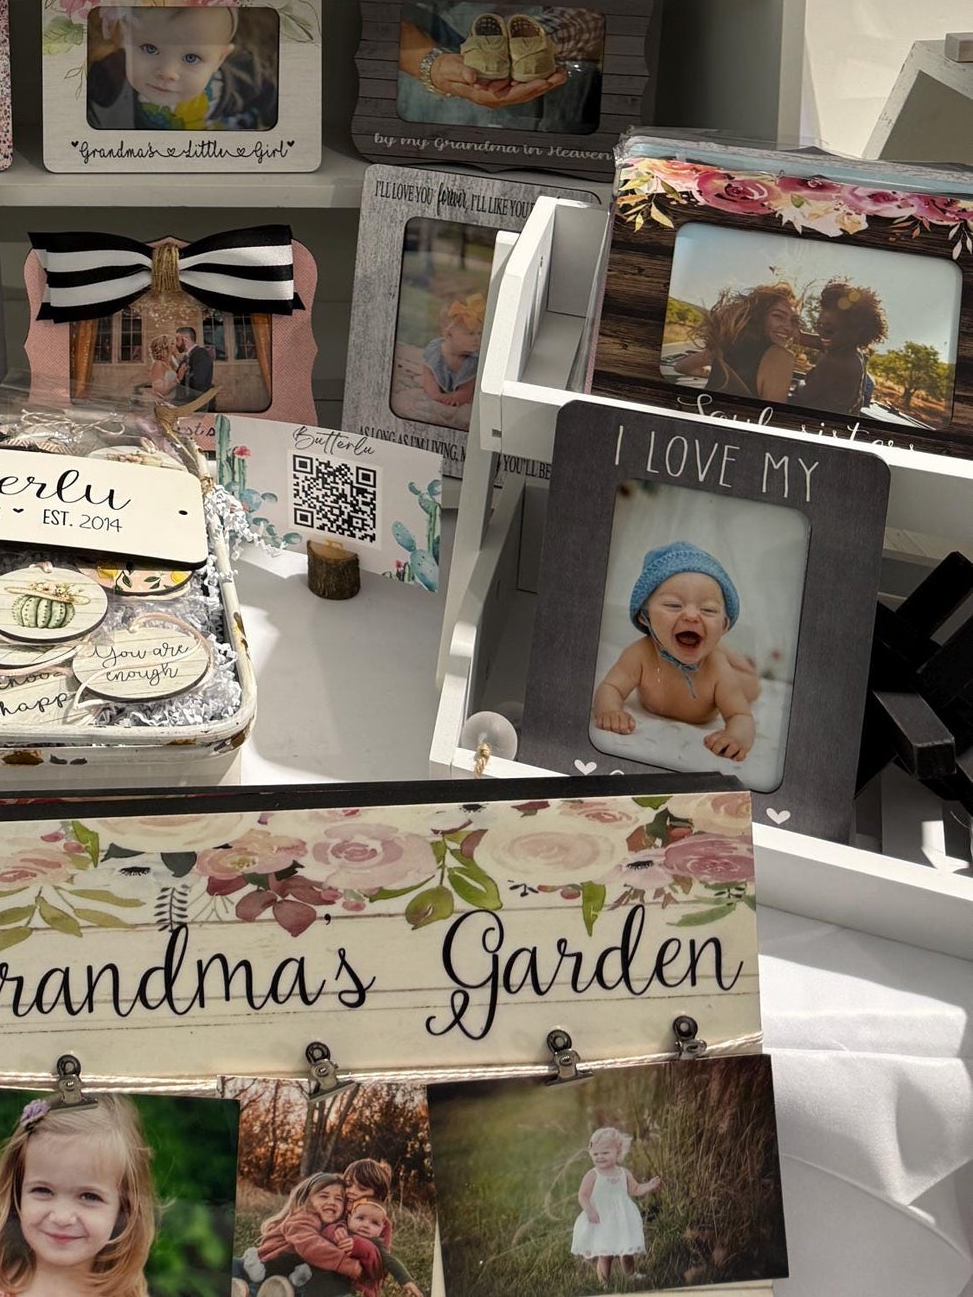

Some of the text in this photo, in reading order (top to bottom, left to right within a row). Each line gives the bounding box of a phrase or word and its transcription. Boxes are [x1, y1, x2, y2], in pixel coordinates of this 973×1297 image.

[184, 140, 228, 158] Little
[253, 141, 288, 164] Girl
[374, 133, 613, 161] by my Grandma in Heaven
[392, 182, 414, 201] LOVE
[414, 186, 433, 205] YOU
[488, 196, 509, 215] LIKE
[508, 200, 528, 218] YOU
[293, 426, 376, 456] Butterlu
[614, 425, 624, 466] I
[646, 431, 740, 488] LOVE
[762, 451, 819, 502] MY
[42, 509, 73, 528] EST.
[79, 514, 123, 532] 2014
[92, 643, 189, 668] You are
[106, 663, 178, 686] enough
[426, 904, 743, 1040] Garden
